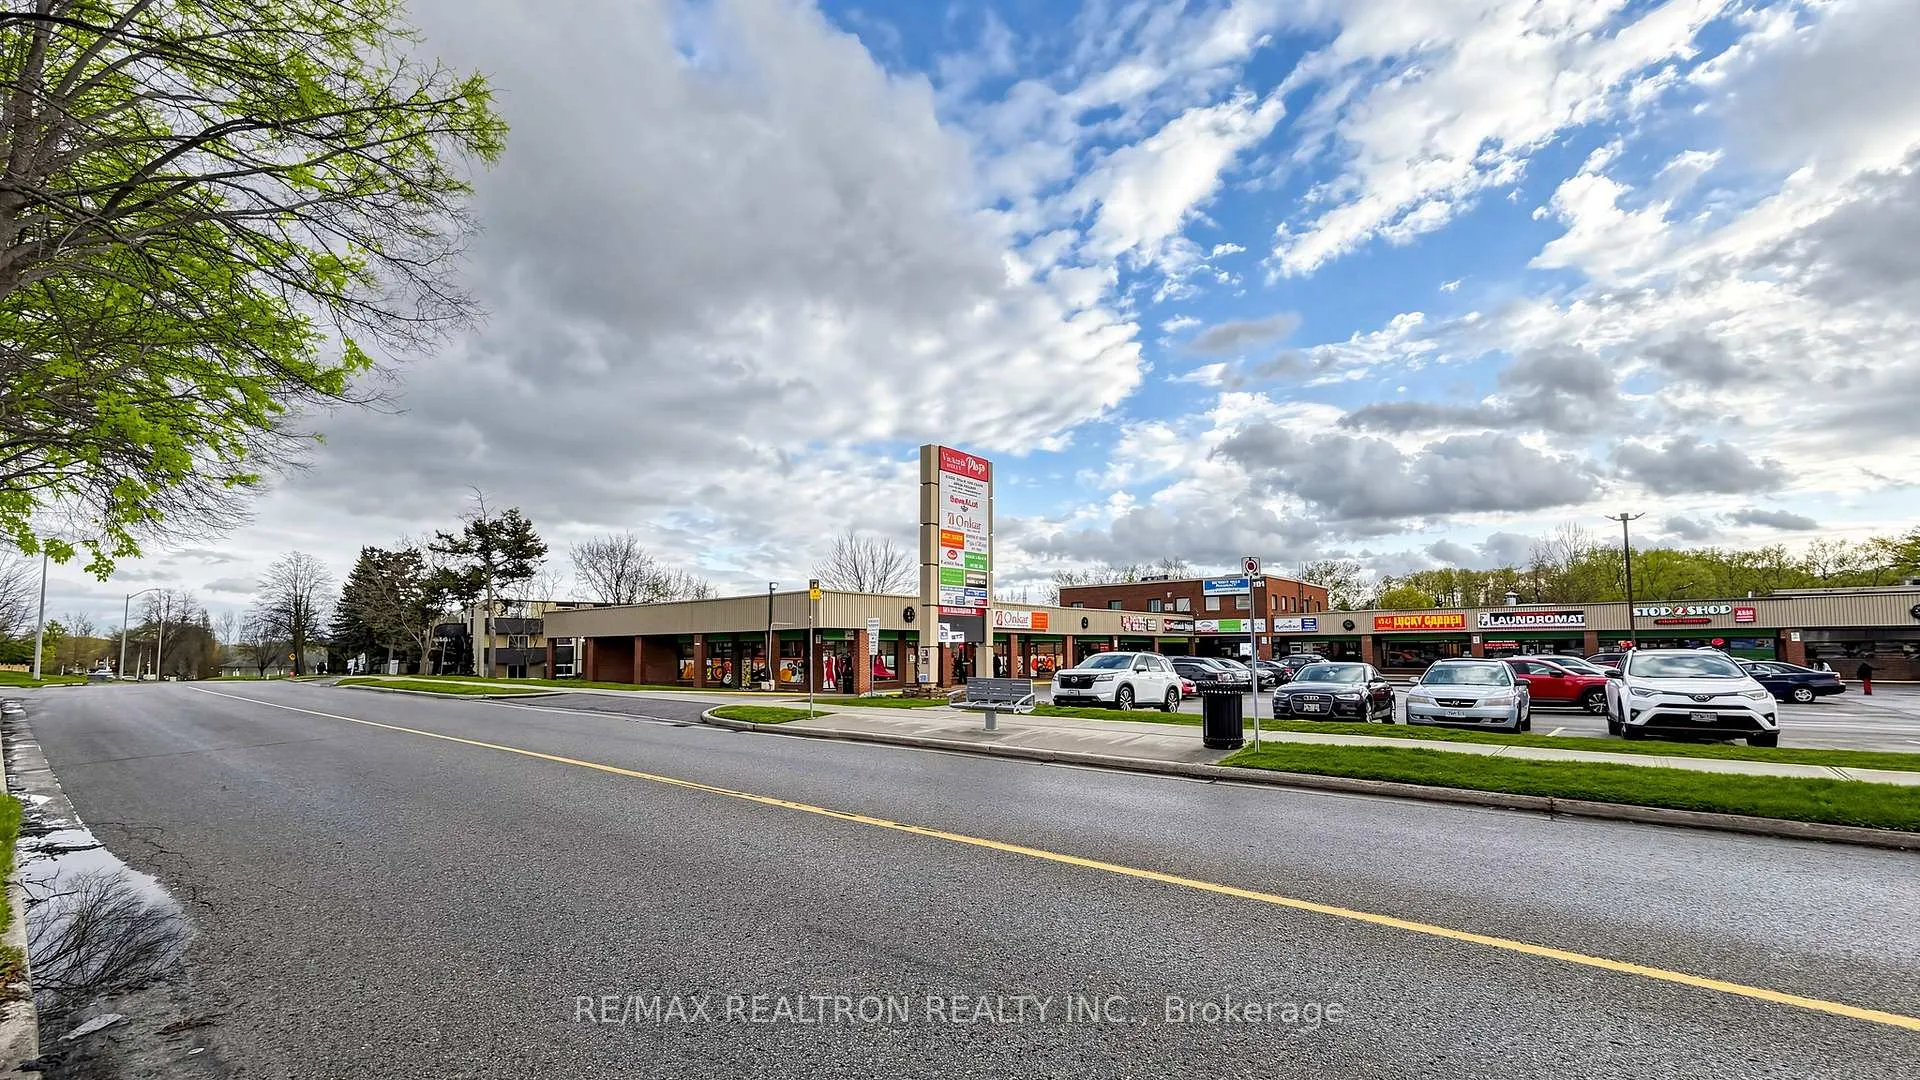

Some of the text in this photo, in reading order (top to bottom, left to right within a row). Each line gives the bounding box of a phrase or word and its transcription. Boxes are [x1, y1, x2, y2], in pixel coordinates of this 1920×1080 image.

[1004, 611, 1029, 625] Onkar
[1393, 615, 1423, 626] LUCKY
[1424, 614, 1462, 626] GARDEN
[1490, 614, 1585, 625] LAUNDROMAT
